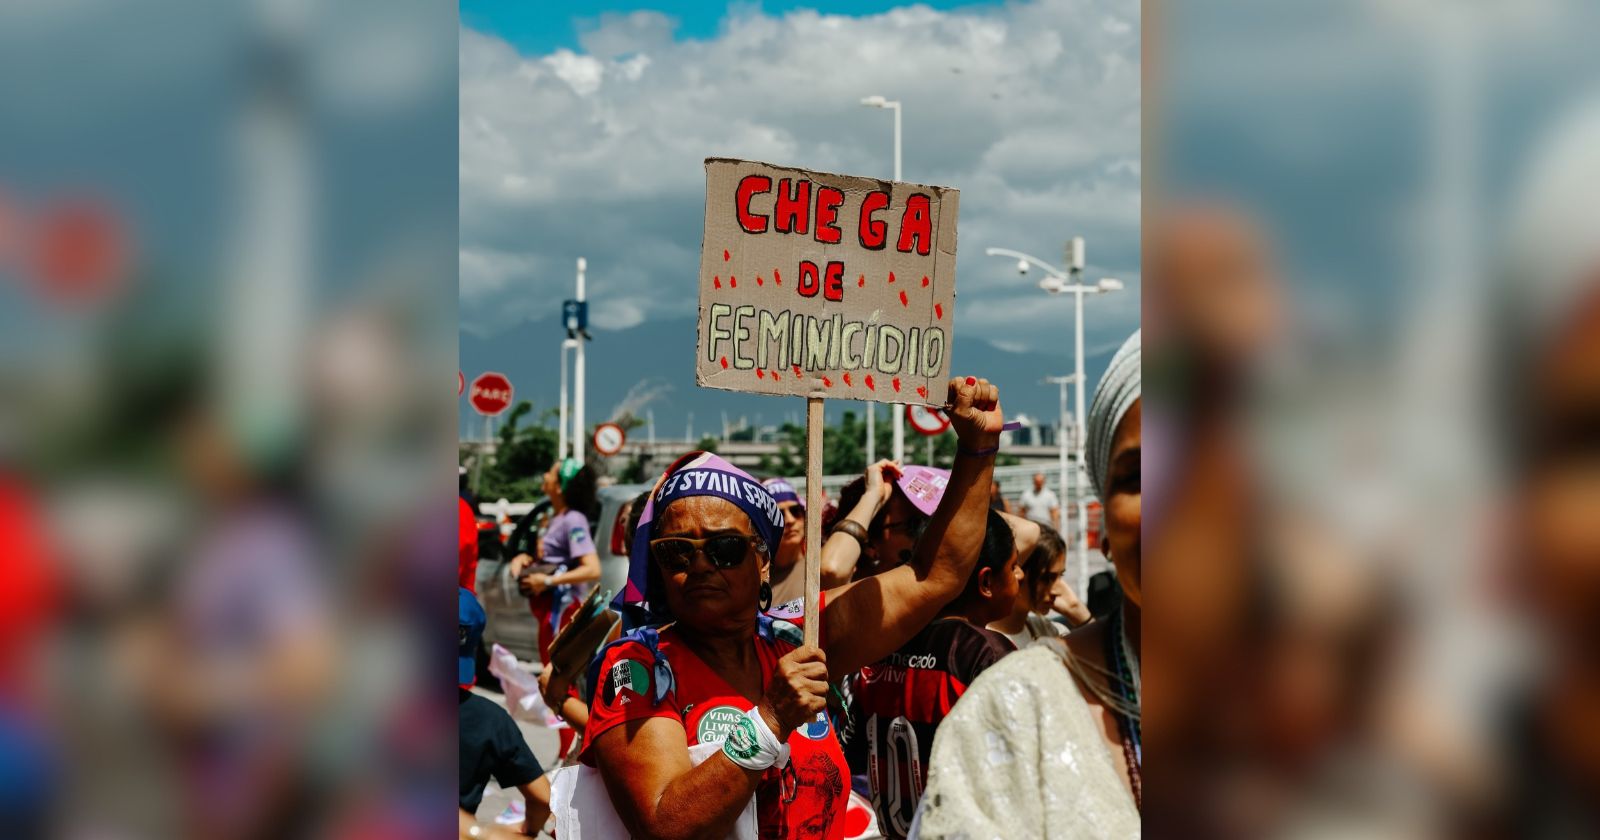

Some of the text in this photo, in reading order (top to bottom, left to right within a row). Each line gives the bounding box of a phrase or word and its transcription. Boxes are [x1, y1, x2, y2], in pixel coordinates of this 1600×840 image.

[735, 175, 932, 256] CHEGA
[798, 261, 845, 302] DE
[708, 303, 945, 378] FEMINICÍDIO
[680, 471, 742, 499] VIVAS
[614, 677, 631, 688] LIVRE
[709, 711, 741, 722] VIVAS
